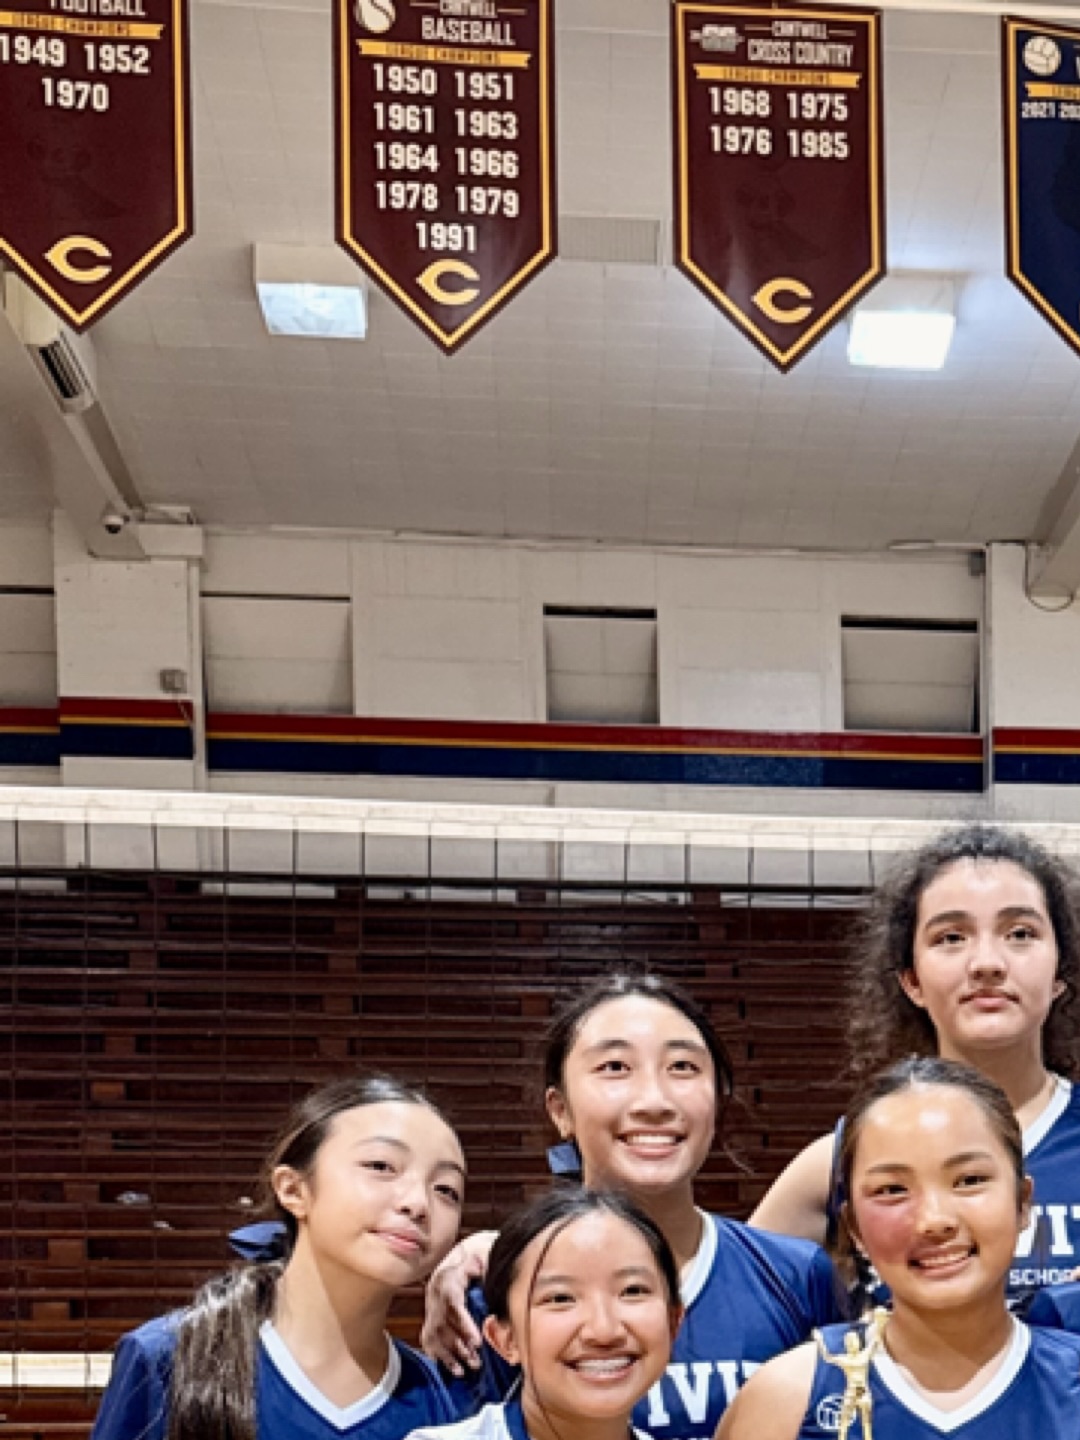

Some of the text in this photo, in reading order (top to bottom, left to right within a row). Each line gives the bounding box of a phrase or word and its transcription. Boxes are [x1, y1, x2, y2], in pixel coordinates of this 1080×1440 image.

[421, 15, 516, 45] BASEBALL
[0, 34, 149, 73] 1949 1952
[747, 38, 853, 67] CROSS COUNTRY
[42, 77, 109, 112] 1970
[374, 63, 513, 100] 1950 1951
[374, 102, 518, 139] 1961 1963
[709, 87, 848, 121] 1968 1975
[374, 141, 519, 178] 1964 1966
[711, 125, 850, 160] 1976 1985
[375, 181, 519, 217] 1978 1979
[416, 220, 476, 252] 1991
[44, 235, 112, 283] C
[416, 258, 480, 305] C
[751, 277, 812, 323] C
[1009, 1268, 1073, 1286] SCHOO
